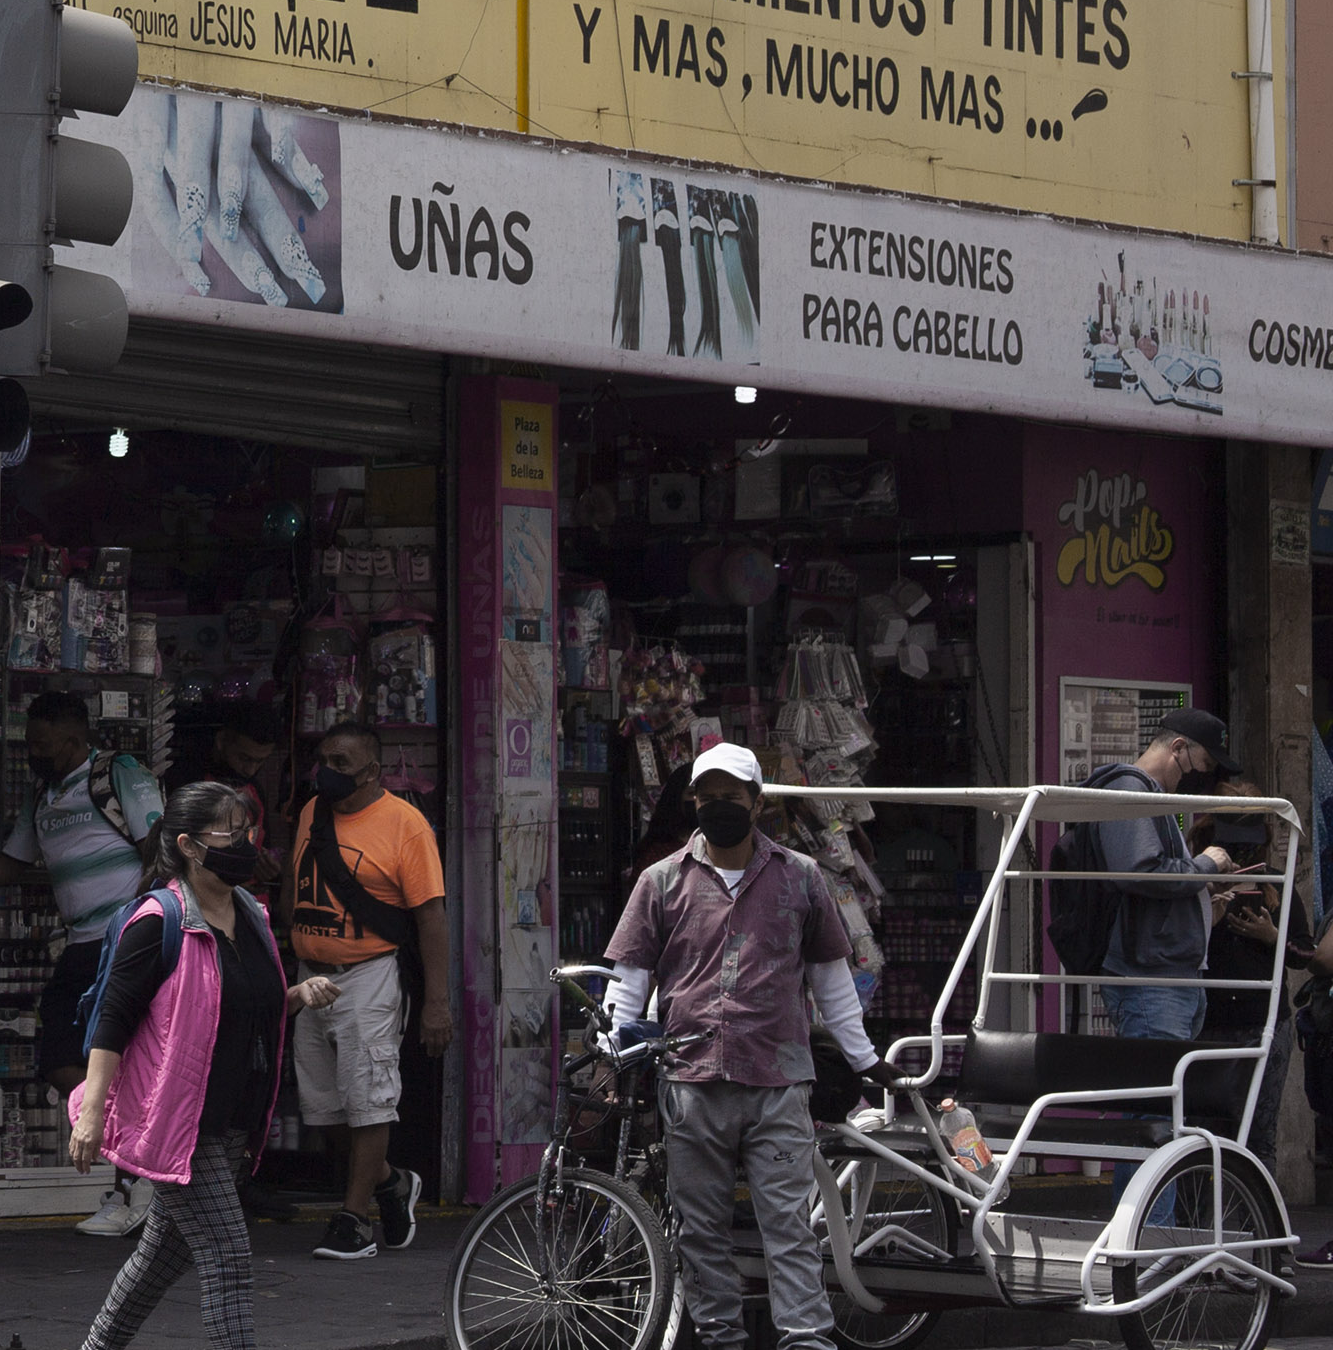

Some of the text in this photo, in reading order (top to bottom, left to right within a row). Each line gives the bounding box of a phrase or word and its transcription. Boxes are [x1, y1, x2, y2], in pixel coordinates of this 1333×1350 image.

[190, 1, 256, 50] JESUS
[572, 3, 899, 116] Y MUCHO
[389, 181, 533, 285] UÑAS
[810, 221, 1014, 294] EXTENSIONES
[802, 293, 1023, 366] PARA CABELLO
[515, 416, 540, 434] Plaza
[515, 440, 539, 456] de la
[511, 463, 544, 481] Belleza
[1059, 468, 1147, 532] Pop
[1057, 506, 1175, 589] Nails
[50, 811, 93, 832] Soriana
